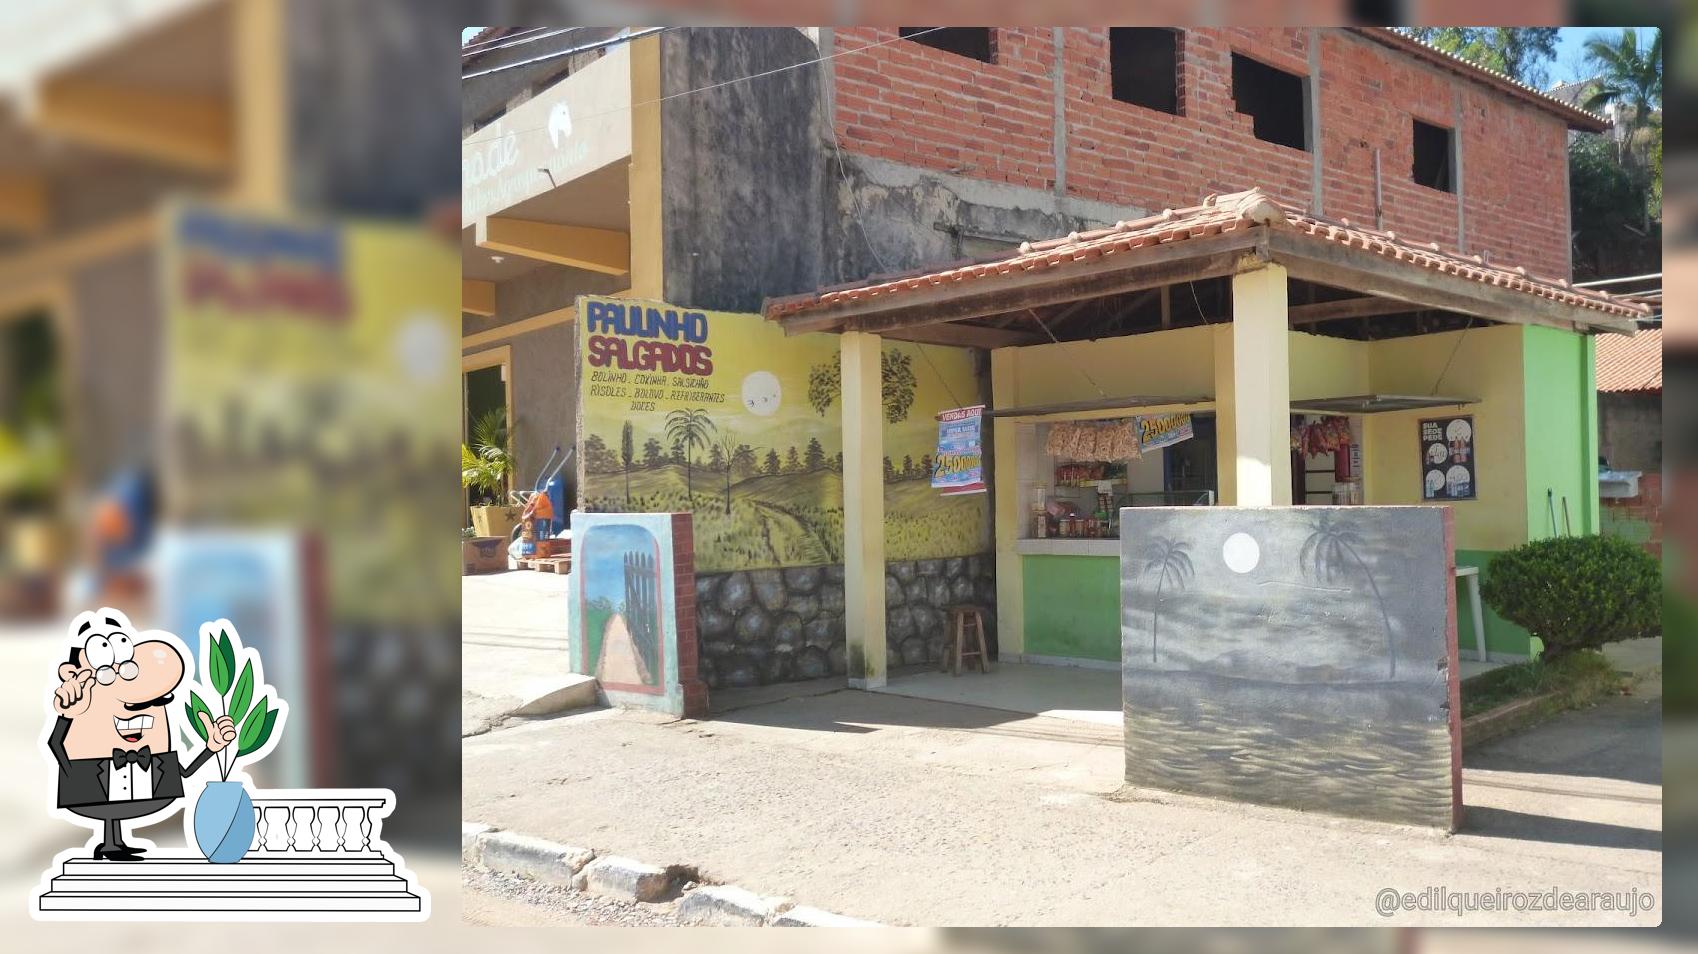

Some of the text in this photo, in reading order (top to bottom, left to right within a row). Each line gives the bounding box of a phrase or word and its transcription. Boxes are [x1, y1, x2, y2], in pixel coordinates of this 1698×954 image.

[587, 301, 708, 343] PAULINHO
[588, 335, 713, 376] SALGADOS
[634, 388, 664, 399] BOLOVO
[670, 390, 726, 403] REFRIGERANTES
[630, 401, 656, 412] DOCES
[943, 410, 966, 421] VENDAS
